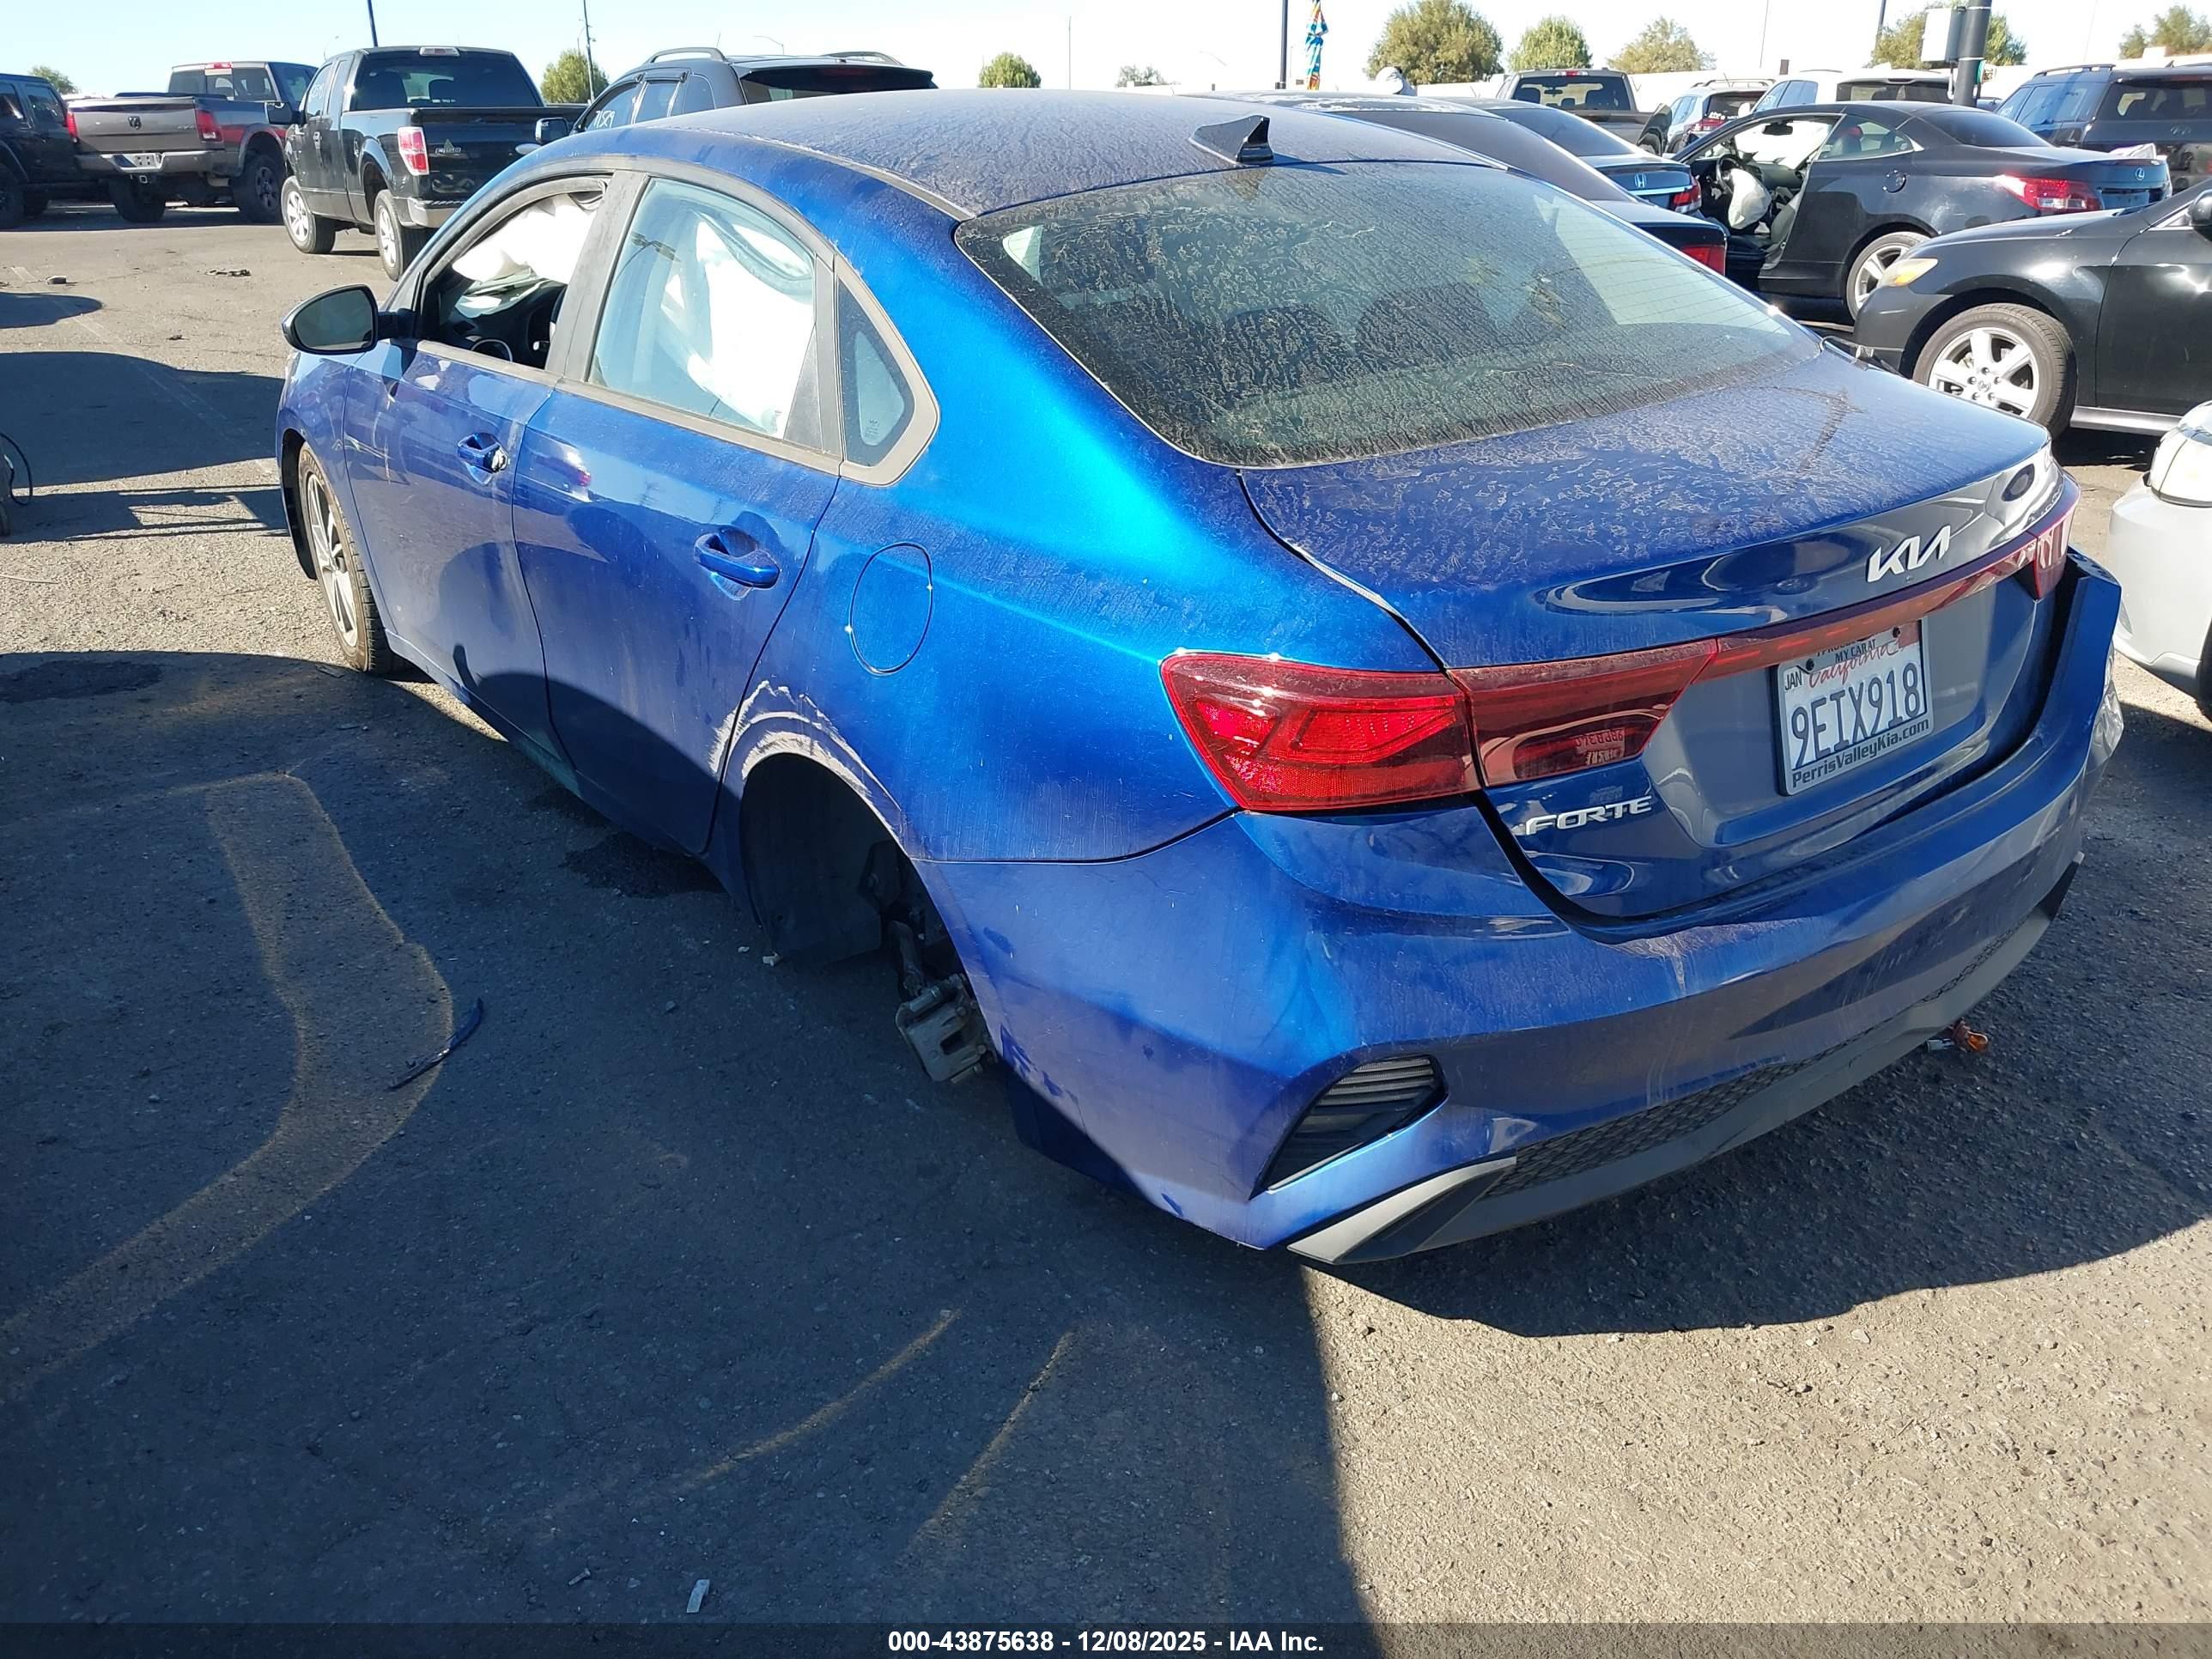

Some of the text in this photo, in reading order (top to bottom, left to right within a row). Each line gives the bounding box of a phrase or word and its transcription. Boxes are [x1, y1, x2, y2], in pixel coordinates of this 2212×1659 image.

[1835, 649, 1849, 664] MY
[1784, 672, 1802, 690] JAN
[1791, 662, 1920, 769] 9EIX918
[1792, 718, 1929, 787] PerrisValleyKia.com
[1526, 795, 1652, 836] FORTE
